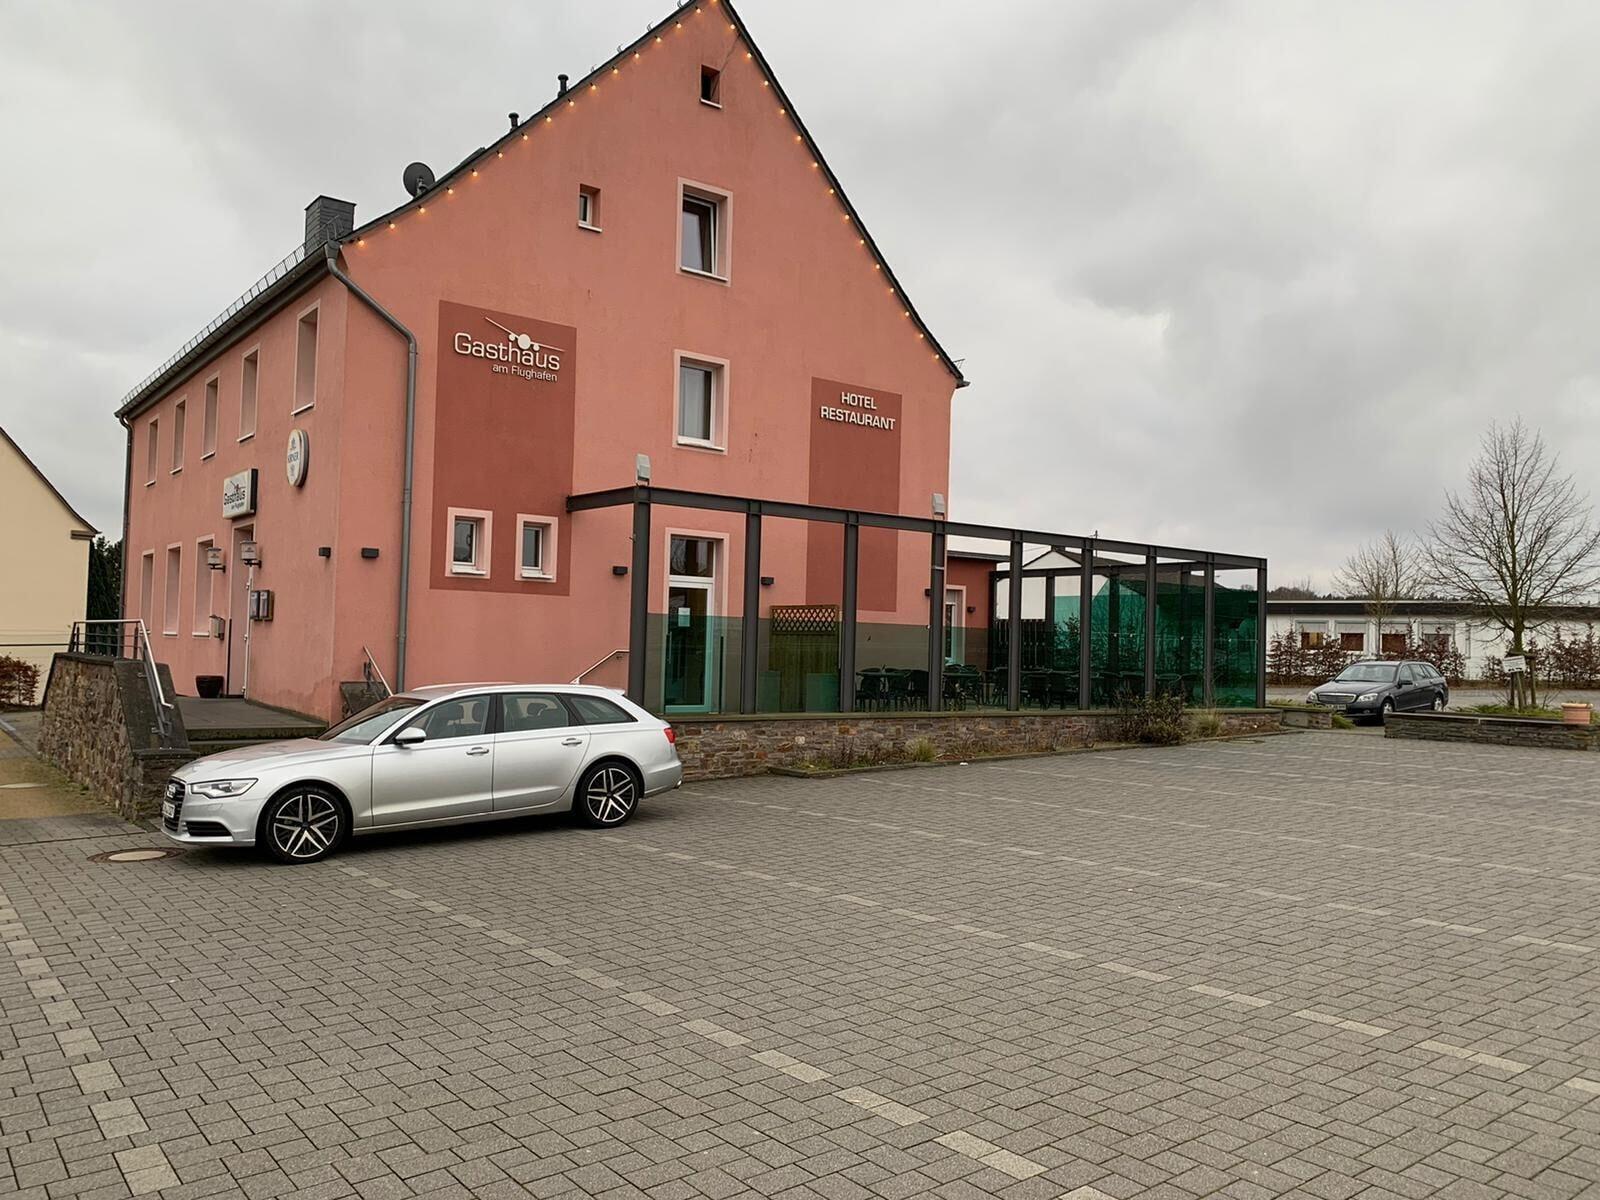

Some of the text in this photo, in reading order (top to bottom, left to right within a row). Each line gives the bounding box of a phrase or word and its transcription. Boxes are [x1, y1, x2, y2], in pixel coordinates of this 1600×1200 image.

[454, 332, 560, 370] Gasthaus
[492, 364, 558, 382] am Flughafen
[841, 391, 877, 410] HOTEL
[820, 406, 896, 430] RESTAURANT
